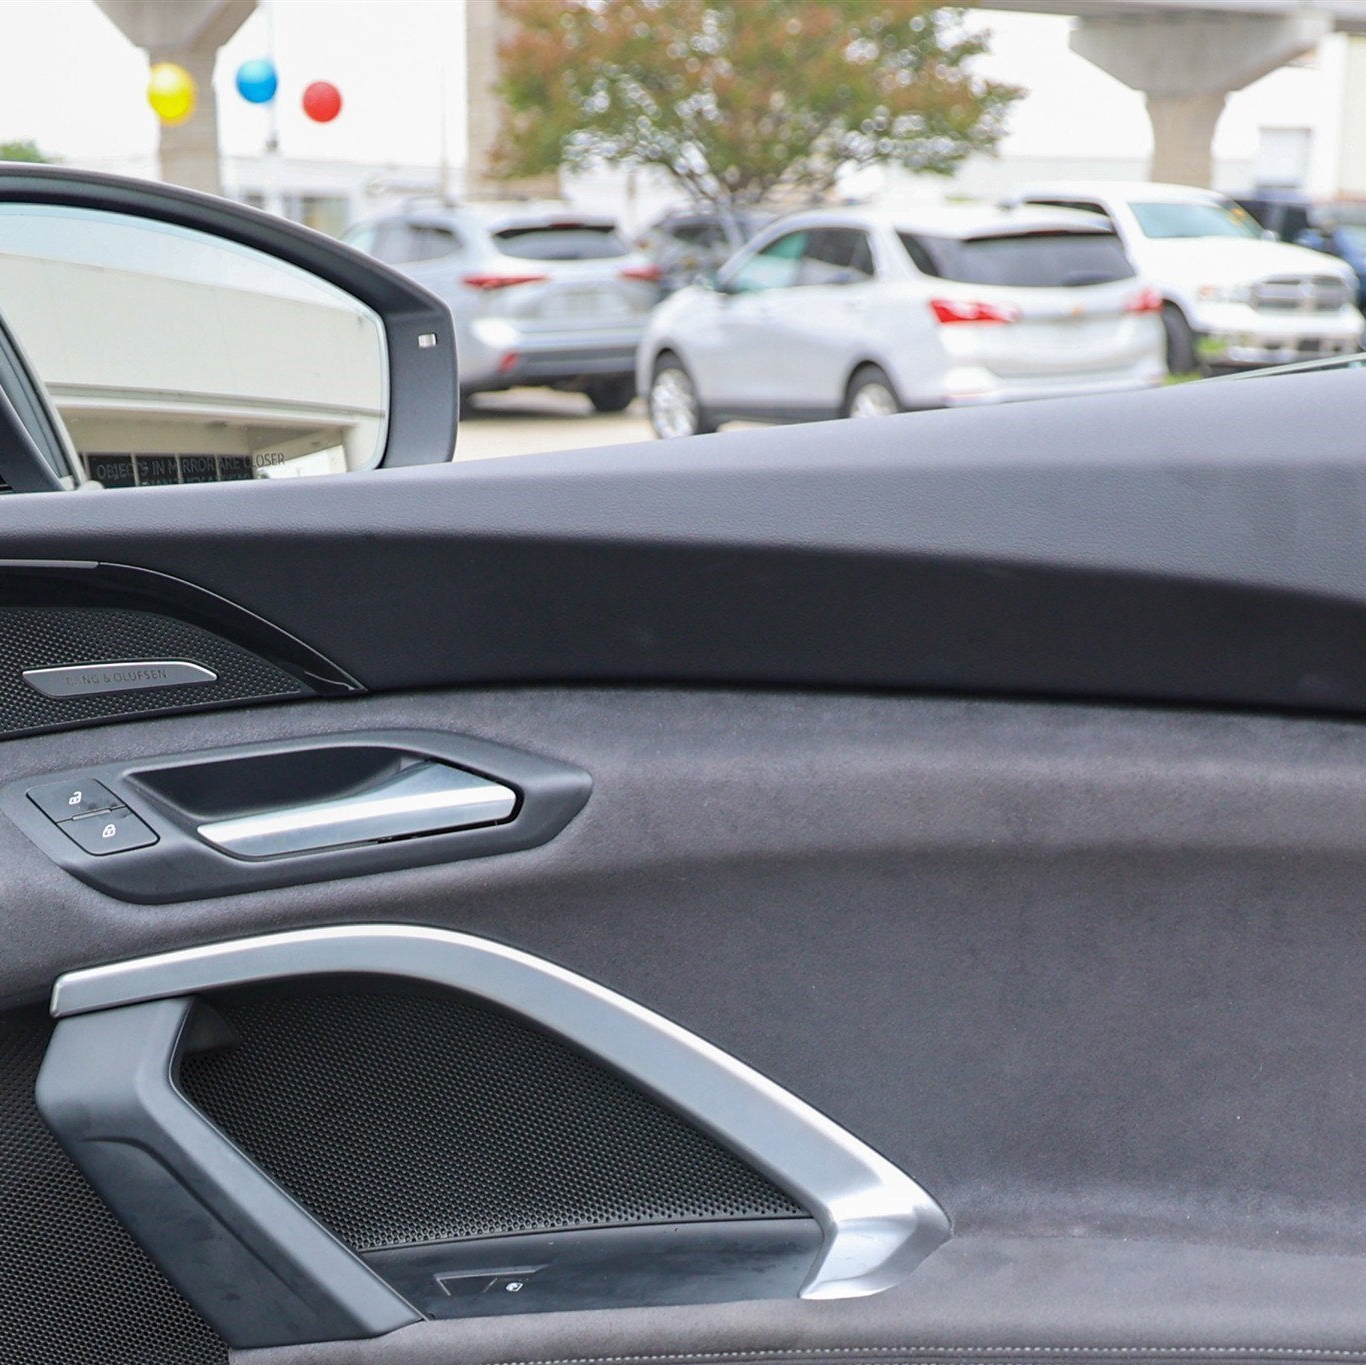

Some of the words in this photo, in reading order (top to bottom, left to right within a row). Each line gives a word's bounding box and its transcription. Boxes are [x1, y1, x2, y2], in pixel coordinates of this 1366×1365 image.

[151, 460, 166, 476] IN
[168, 457, 215, 474] MRROR
[218, 455, 240, 471] ARE
[113, 669, 167, 682] OLUFSEN
